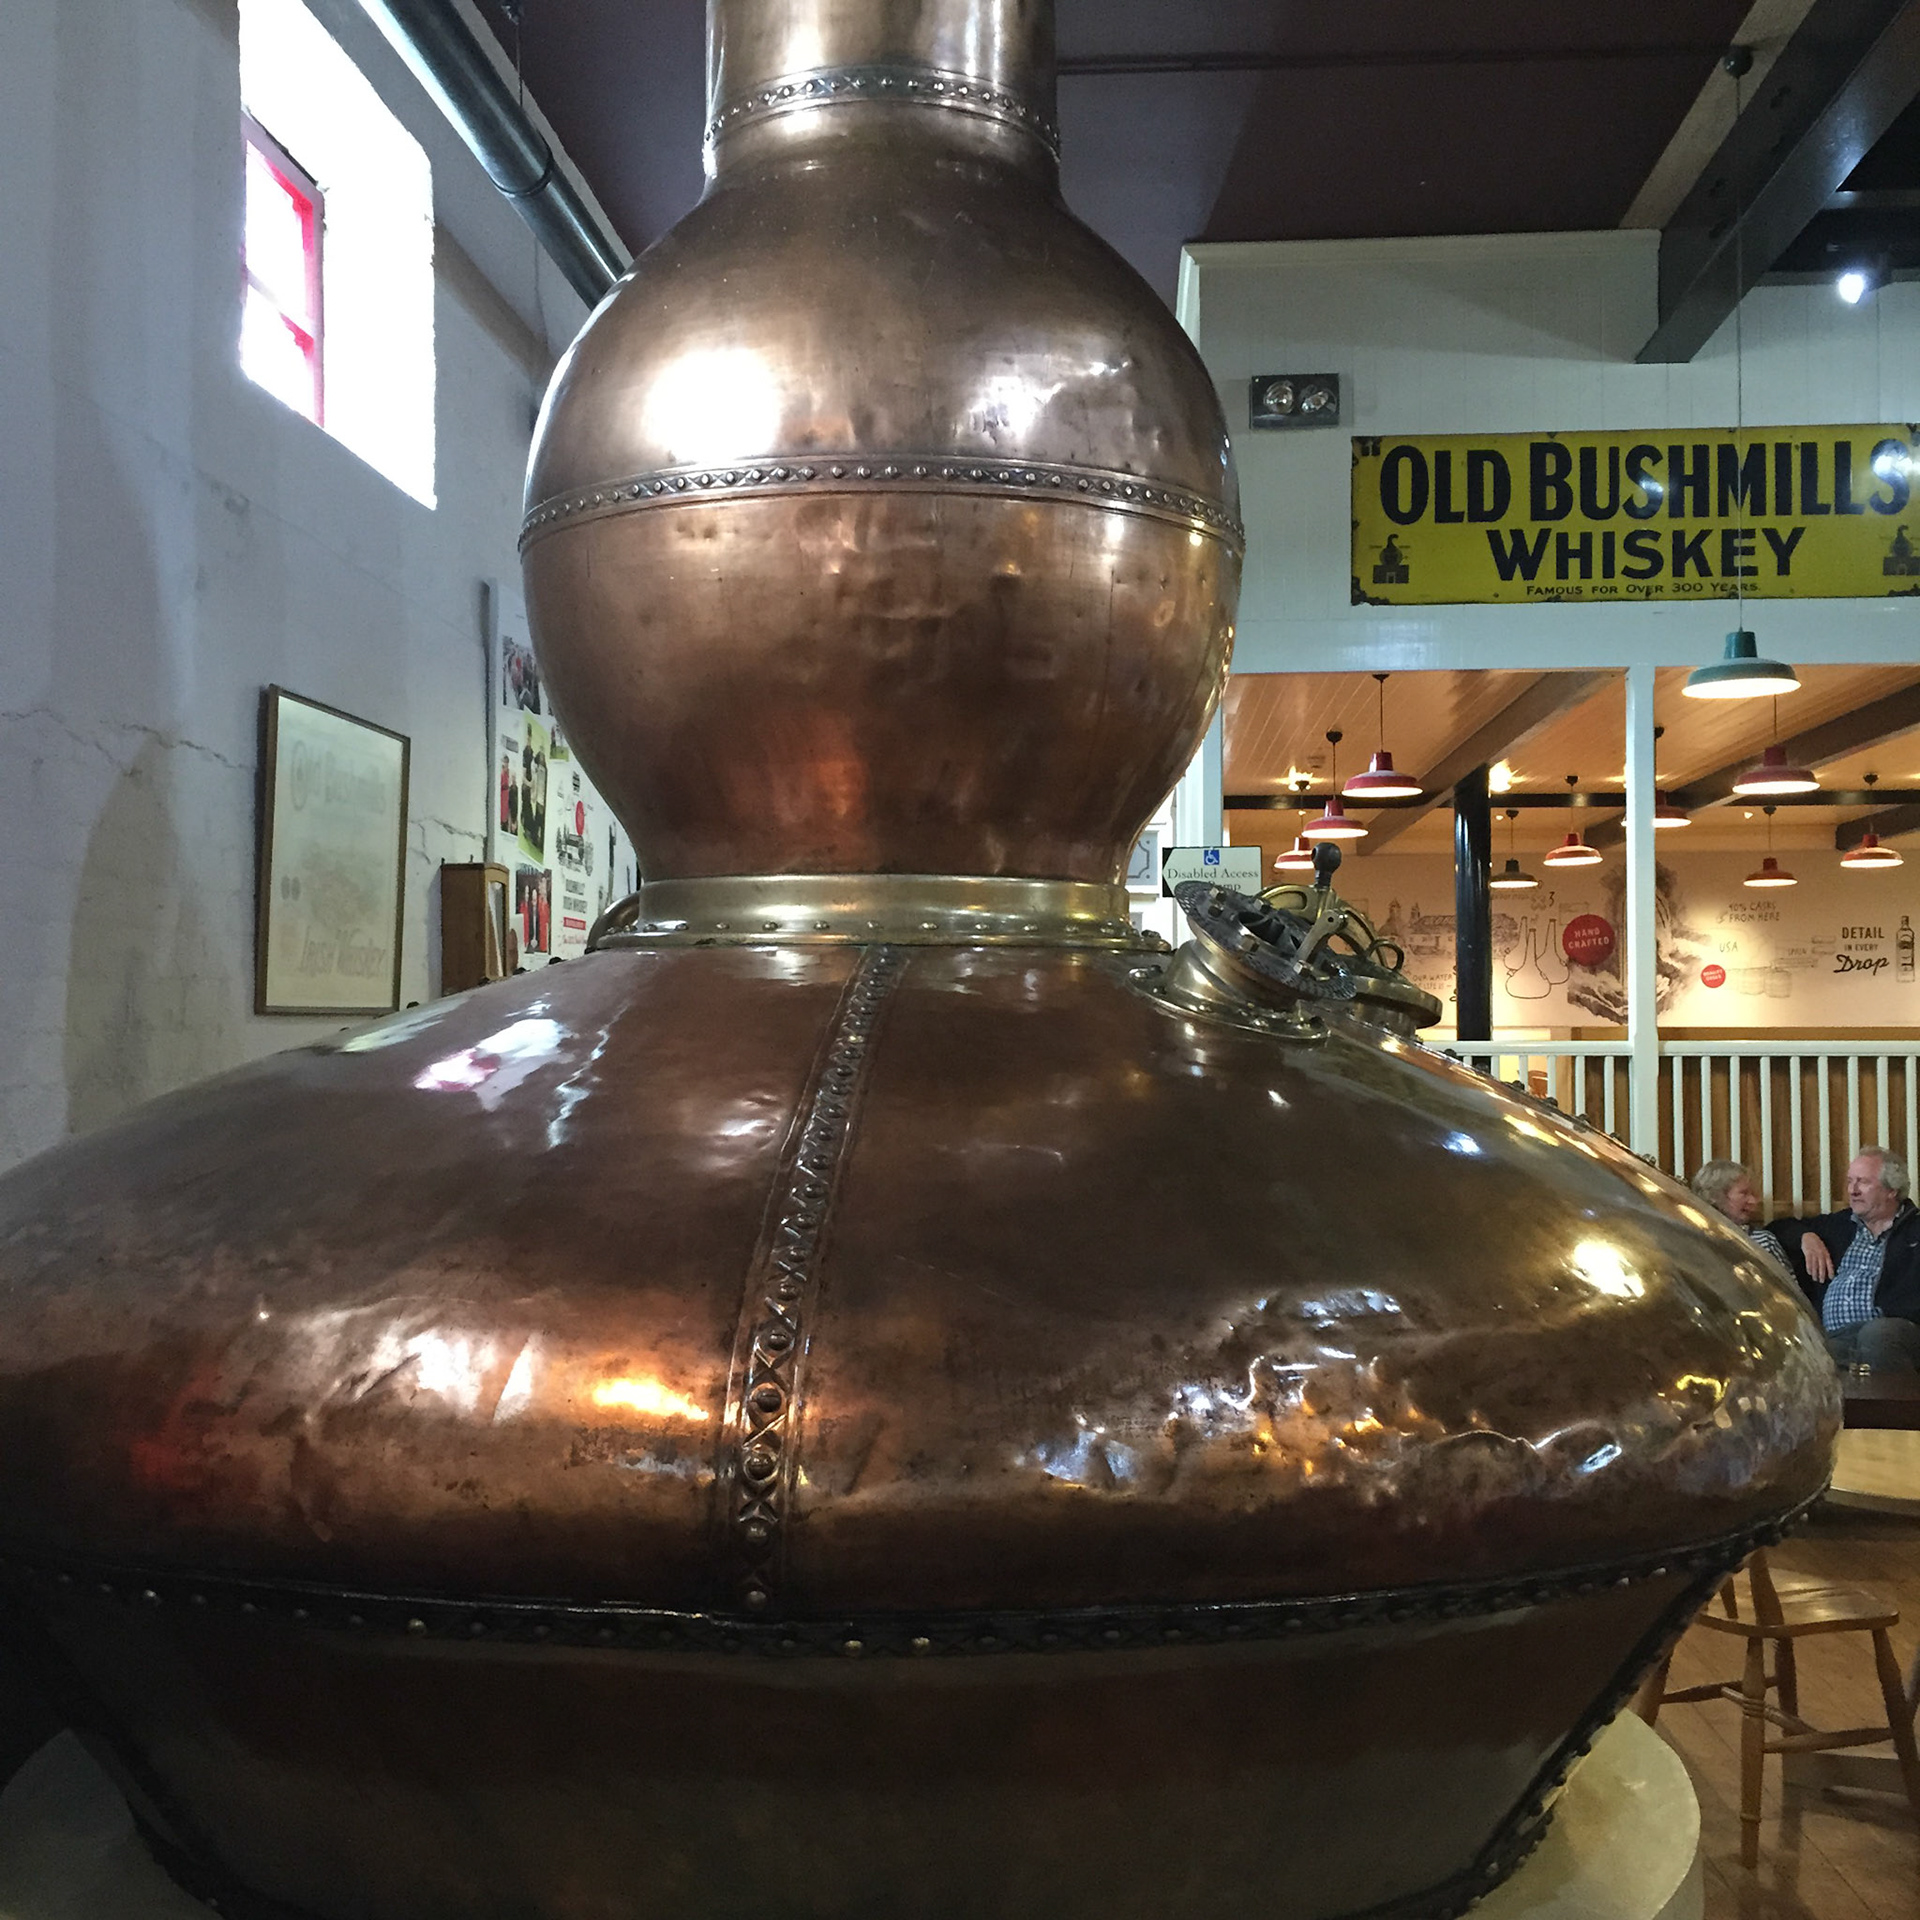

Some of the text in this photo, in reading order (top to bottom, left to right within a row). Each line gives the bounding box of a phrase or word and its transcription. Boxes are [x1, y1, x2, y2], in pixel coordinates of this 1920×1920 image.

[1529, 438, 1911, 523] BUSHMILLS
[1486, 526, 1806, 581] WHISKEY
[1526, 585, 1584, 596] FAMOUS
[1591, 584, 1619, 595] FOR
[1626, 583, 1664, 597] OVER
[1672, 582, 1704, 593] 300
[1166, 867, 1259, 880] Disabled Access
[1729, 911, 1781, 923] FROM HERE
[1574, 926, 1601, 937] HAND
[1841, 926, 1885, 939] DETAIL
[1568, 935, 1610, 949] CRAFTED
[1719, 941, 1738, 953] USA
[1855, 943, 1879, 952] EVERY
[1832, 954, 1890, 976] Drop
[1429, 973, 1453, 982] WATER
